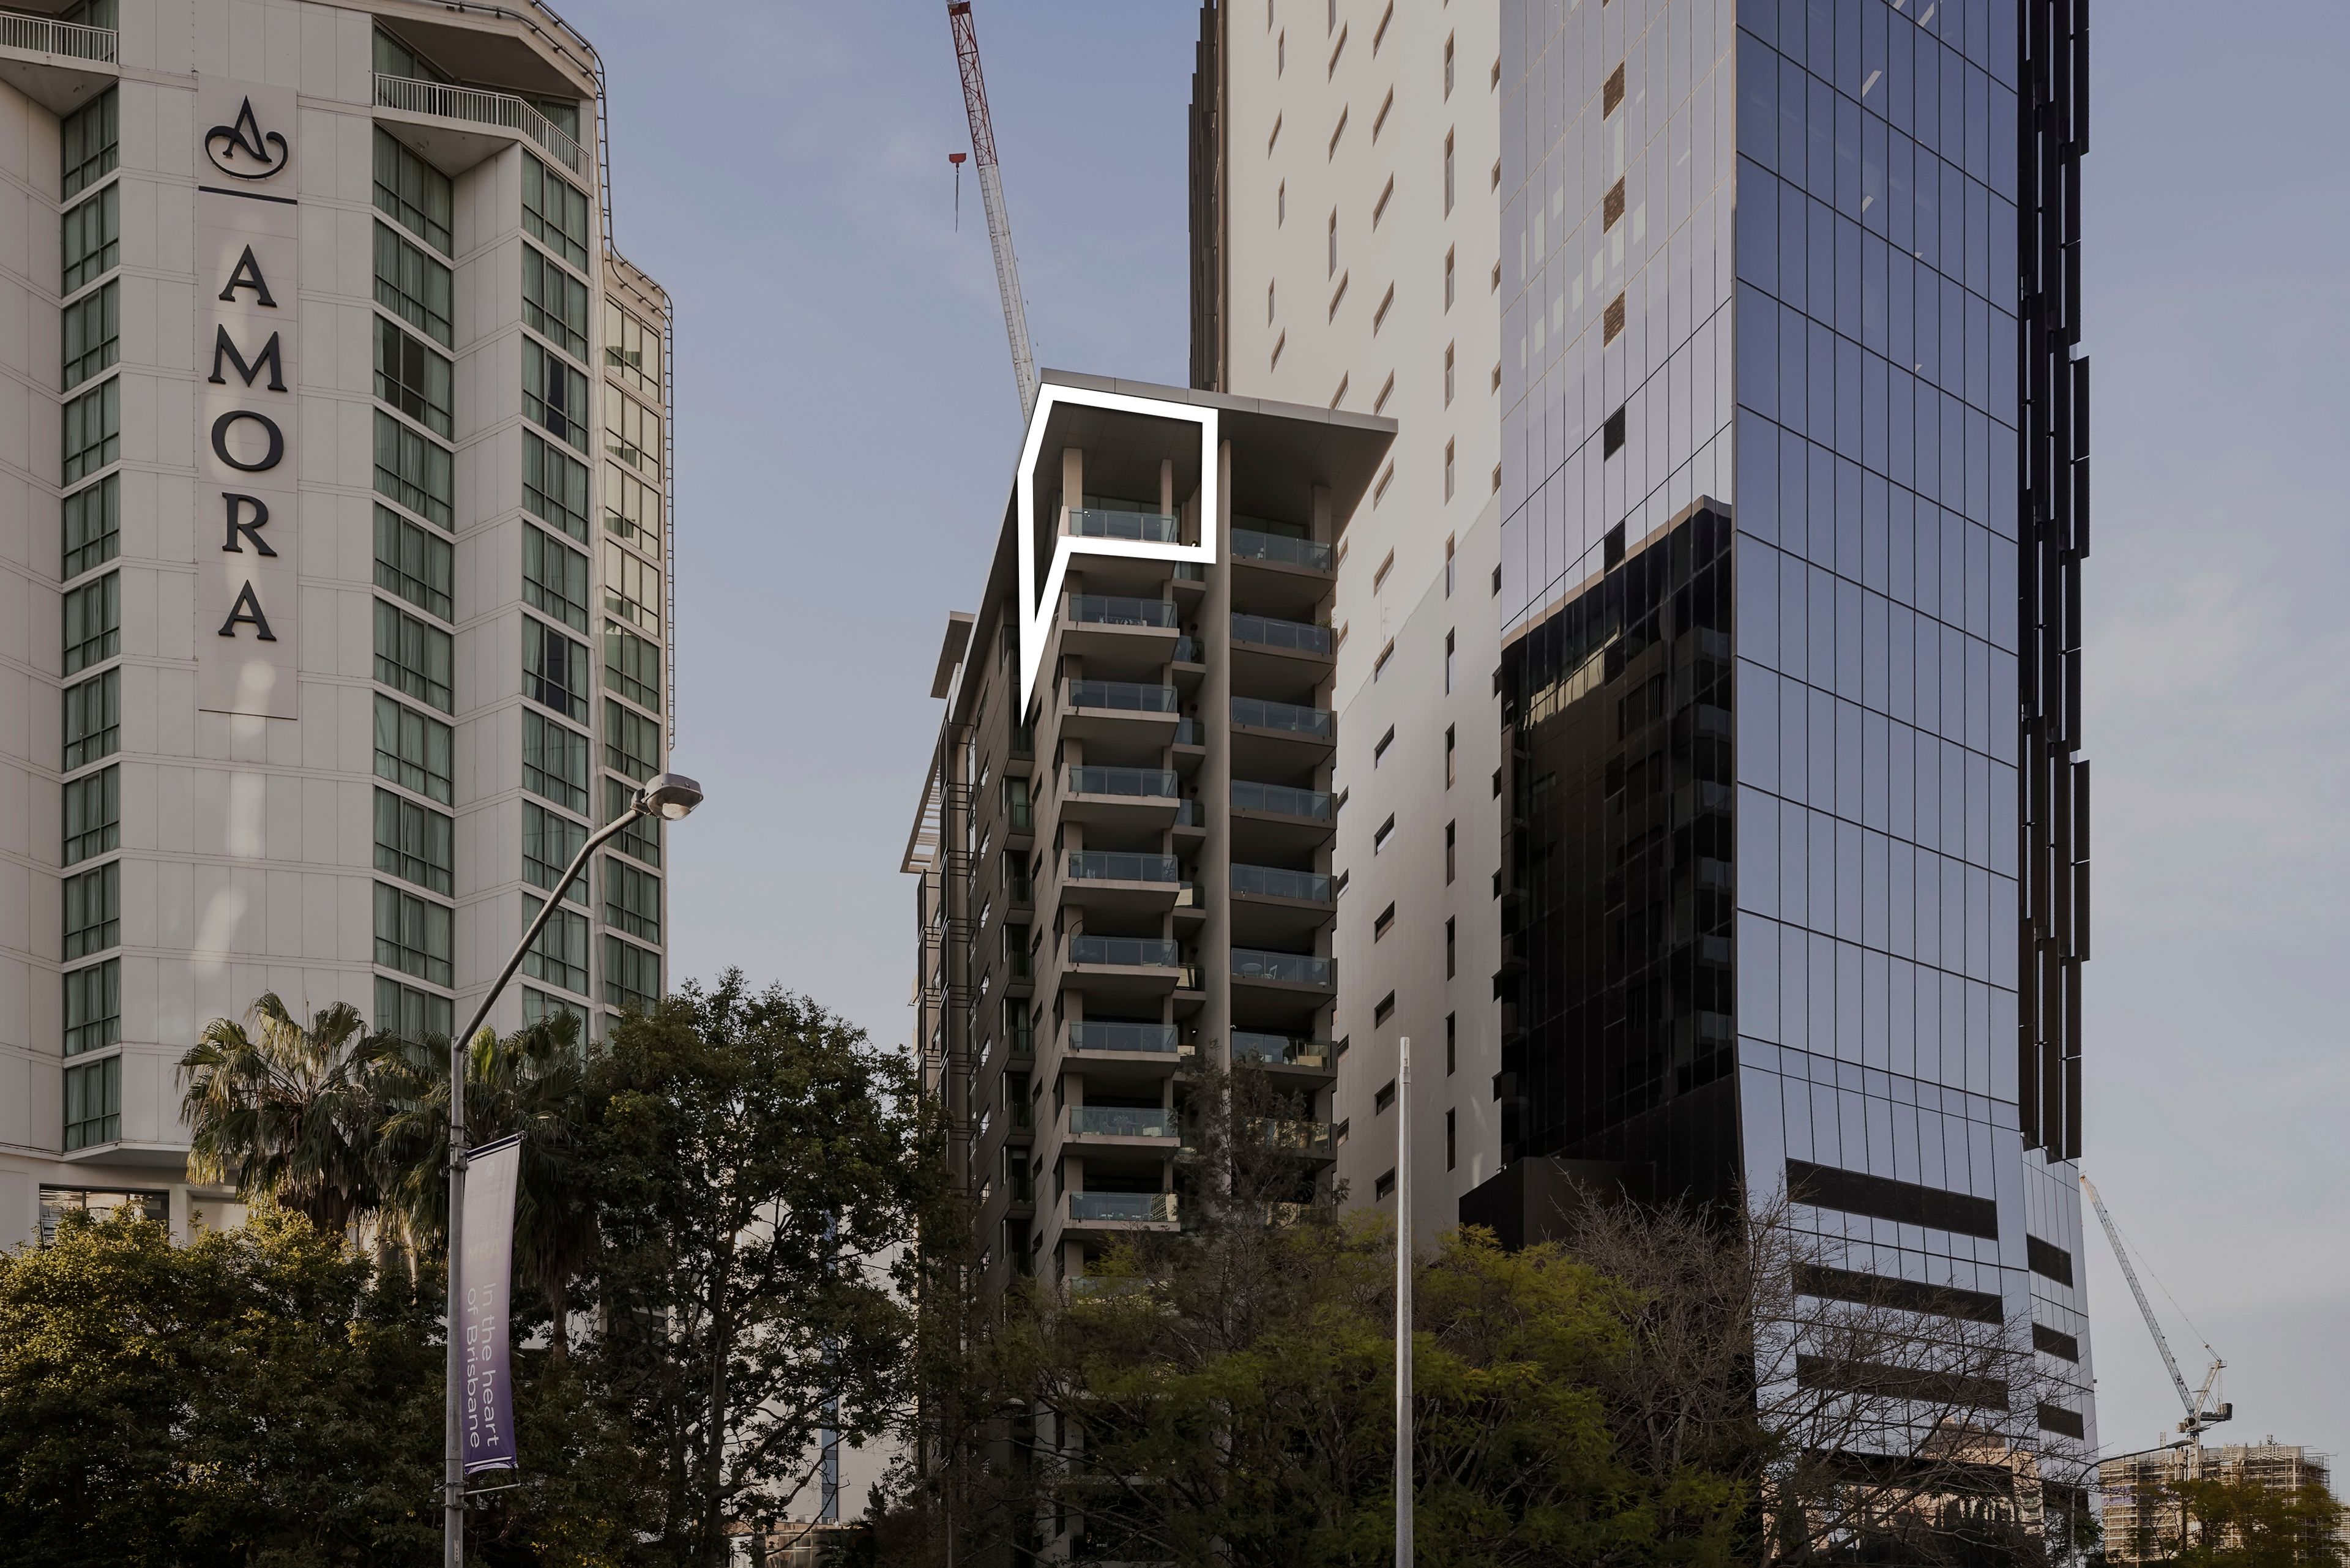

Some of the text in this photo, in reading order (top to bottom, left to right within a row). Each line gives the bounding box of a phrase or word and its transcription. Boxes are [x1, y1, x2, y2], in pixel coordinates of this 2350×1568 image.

[207, 244, 288, 642] AMORA
[467, 1287, 480, 1448] of Brisbane
[482, 1283, 499, 1447] In the heart
